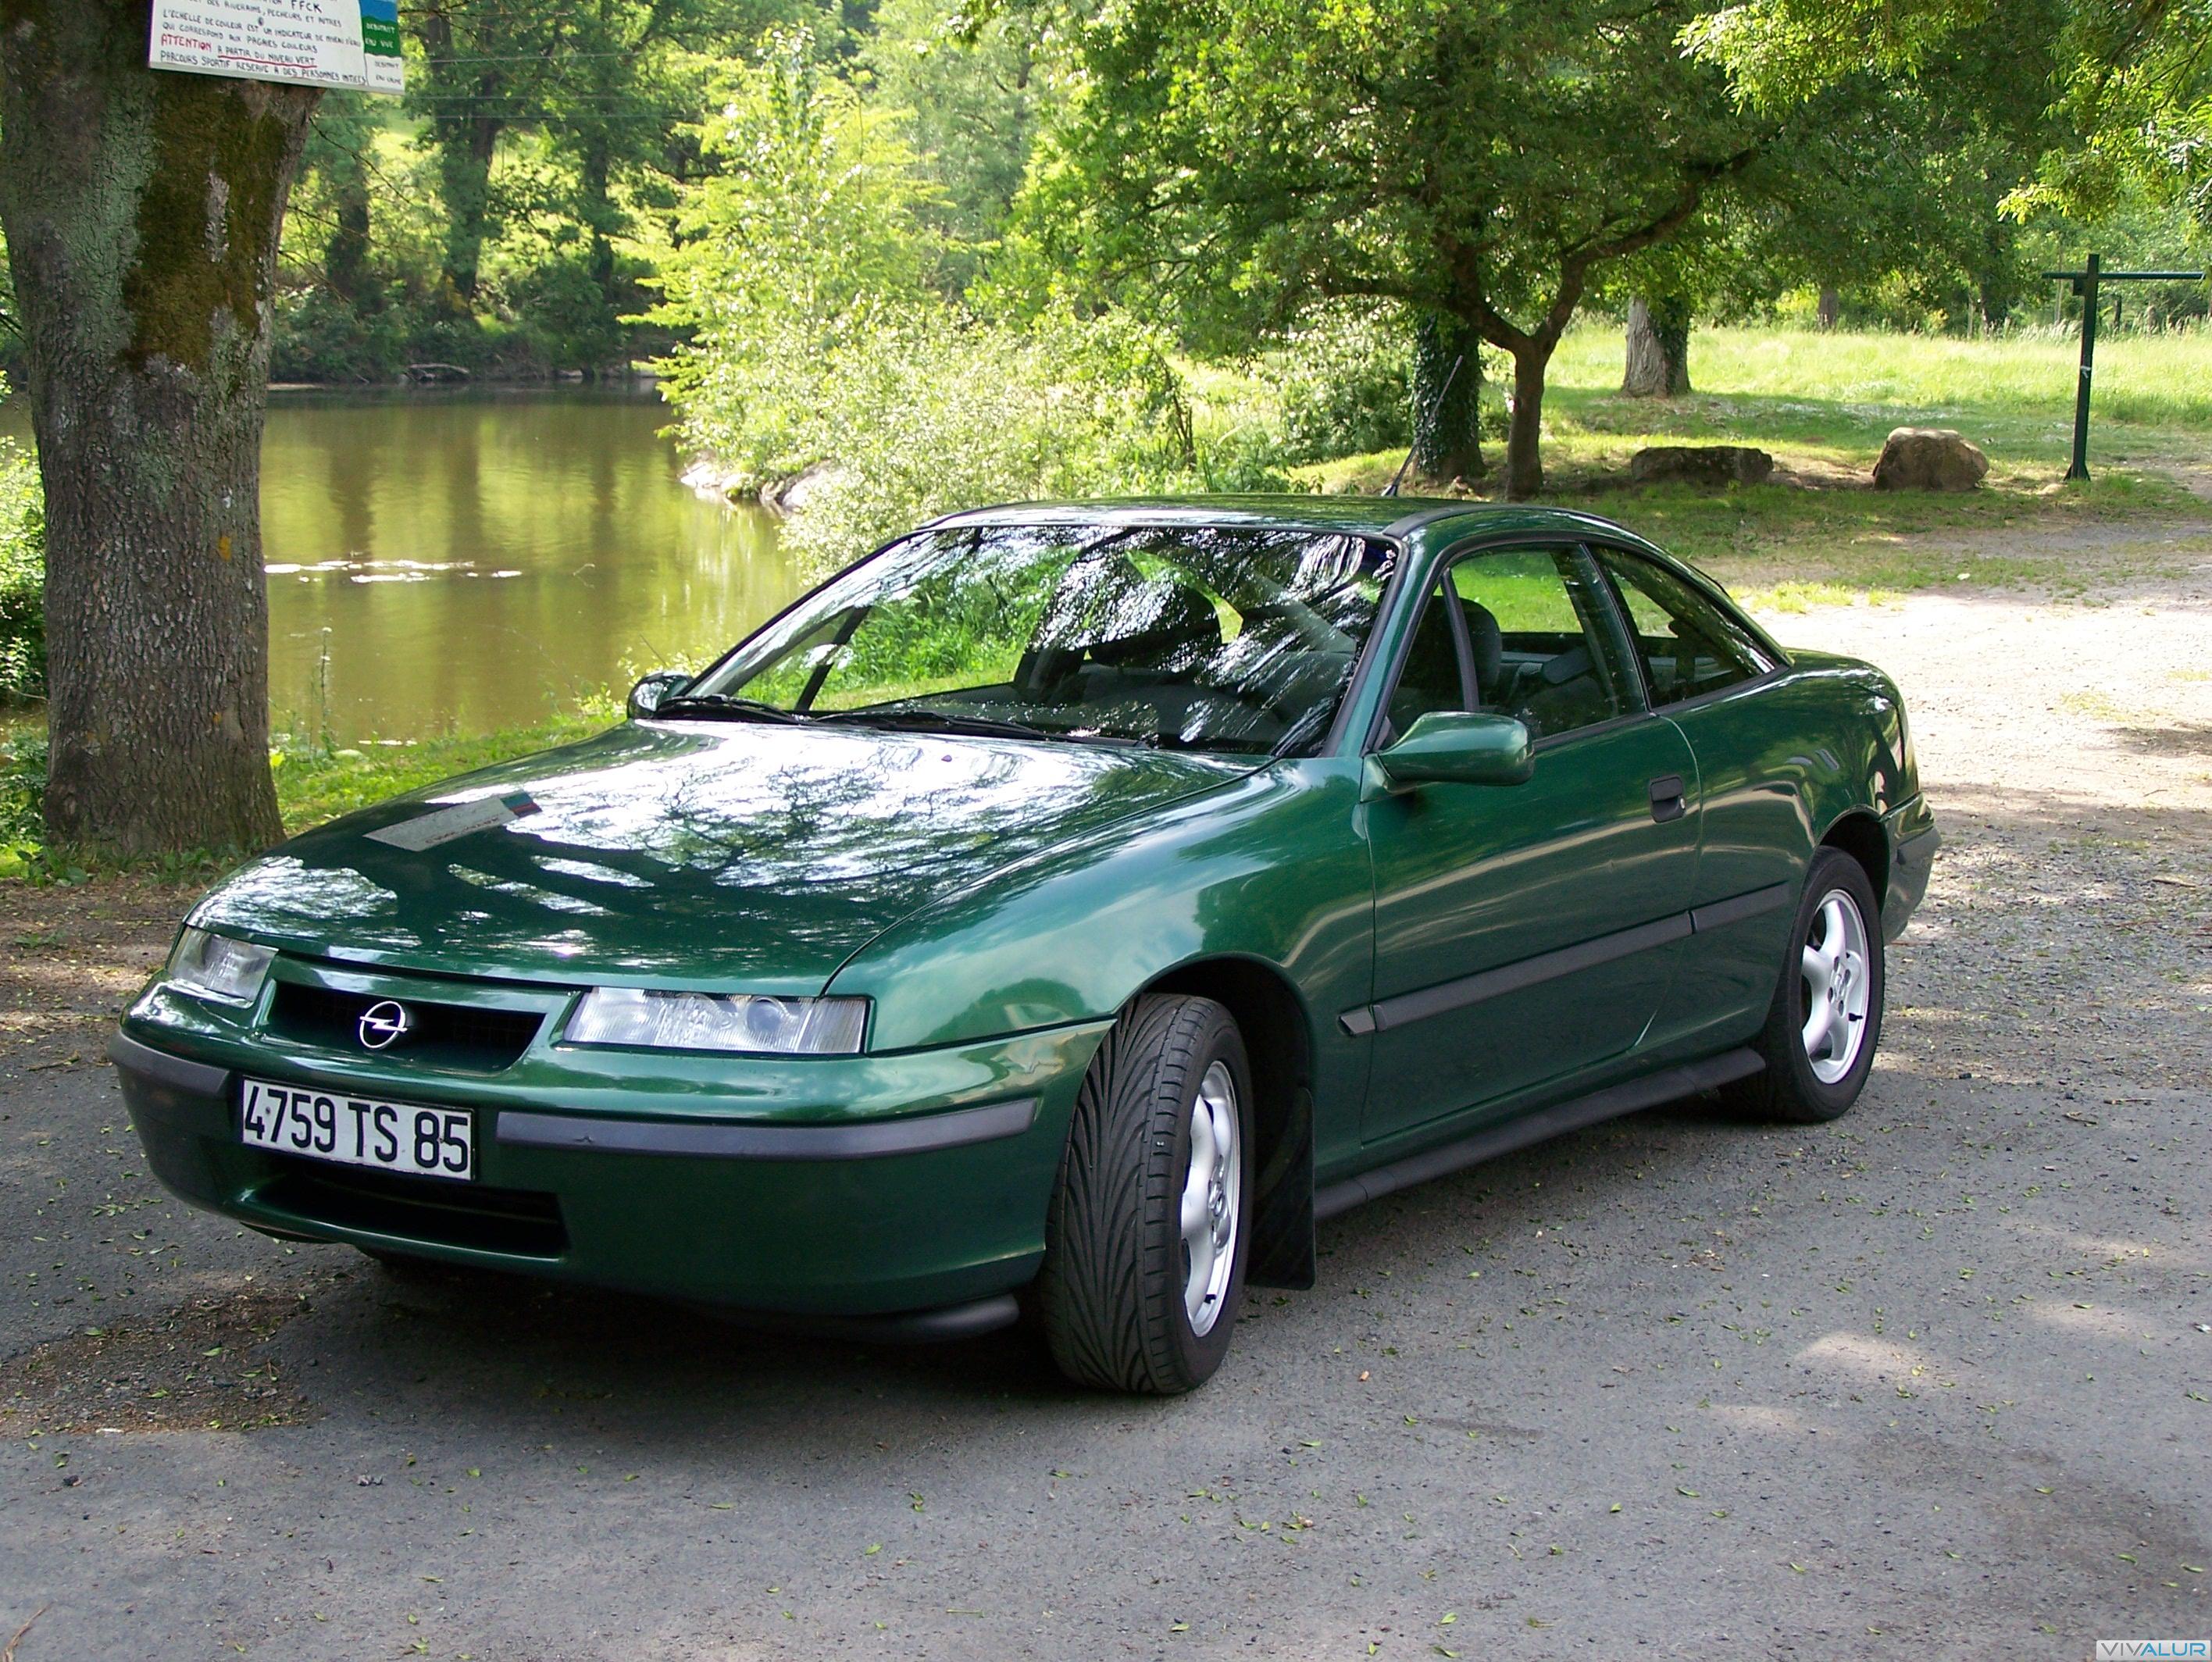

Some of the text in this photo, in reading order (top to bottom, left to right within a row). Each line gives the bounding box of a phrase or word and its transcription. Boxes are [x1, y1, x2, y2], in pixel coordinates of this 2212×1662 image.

[291, 0, 322, 13] FFCK
[162, 22, 175, 30] QUI
[281, 41, 318, 54] COULEURS
[247, 23, 259, 32] EST
[275, 29, 312, 40] INDICATEUR
[160, 33, 212, 52] ATTENTION
[225, 46, 251, 57] PARTIR
[255, 52, 265, 60] DU
[268, 53, 293, 63] NIVEAU
[295, 55, 316, 66] VERT
[160, 49, 198, 66] PARCOURS
[201, 55, 230, 69] SPORTIF
[283, 67, 298, 77] DES
[244, 1086, 469, 1172] 4759 TS 85
